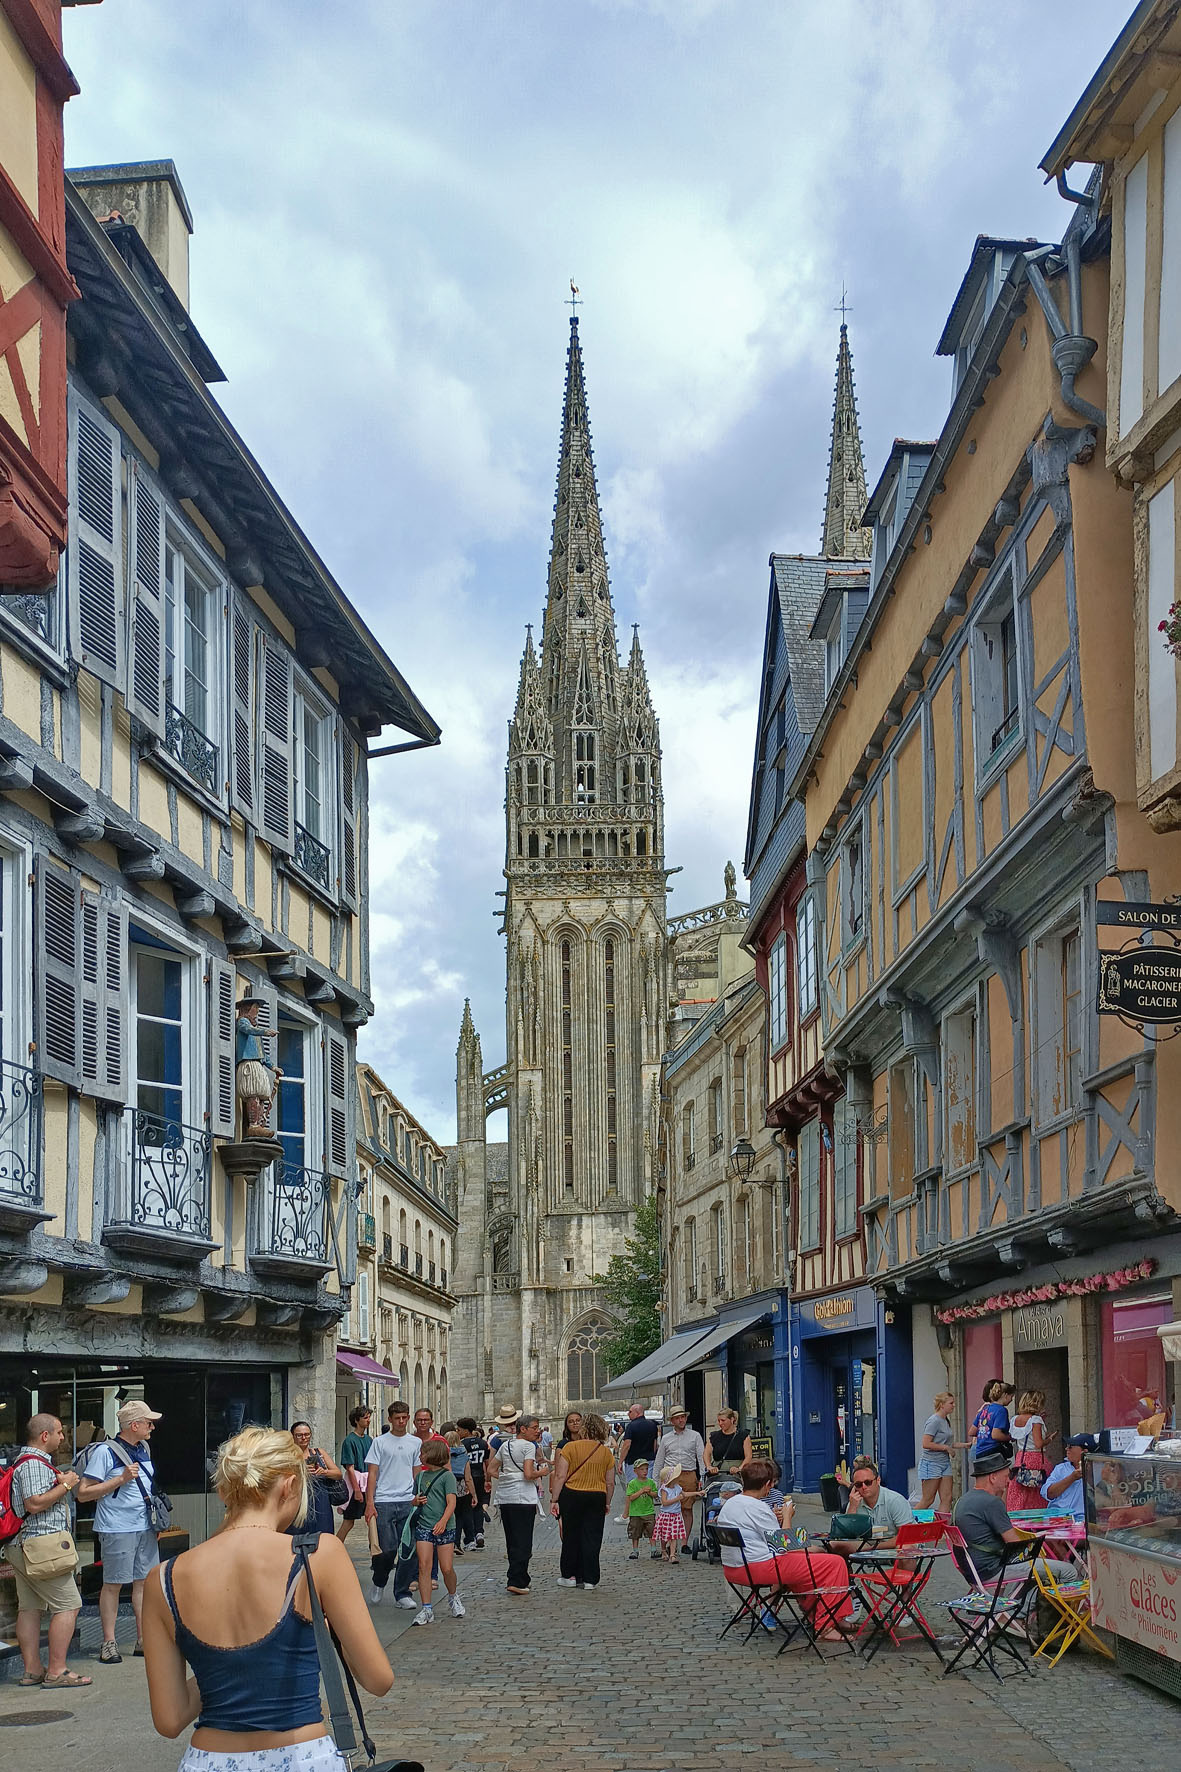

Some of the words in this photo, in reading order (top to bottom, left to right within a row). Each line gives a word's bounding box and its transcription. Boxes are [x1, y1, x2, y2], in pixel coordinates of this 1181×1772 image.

[1118, 910, 1158, 923] SALON
[1161, 913, 1178, 924] DE
[1137, 995, 1178, 1008] GLACIER
[1017, 1308, 1064, 1342] Amaya
[1142, 1567, 1156, 1588] Les
[1129, 1578, 1177, 1622] Glaces
[1137, 1614, 1178, 1644] Philomène
